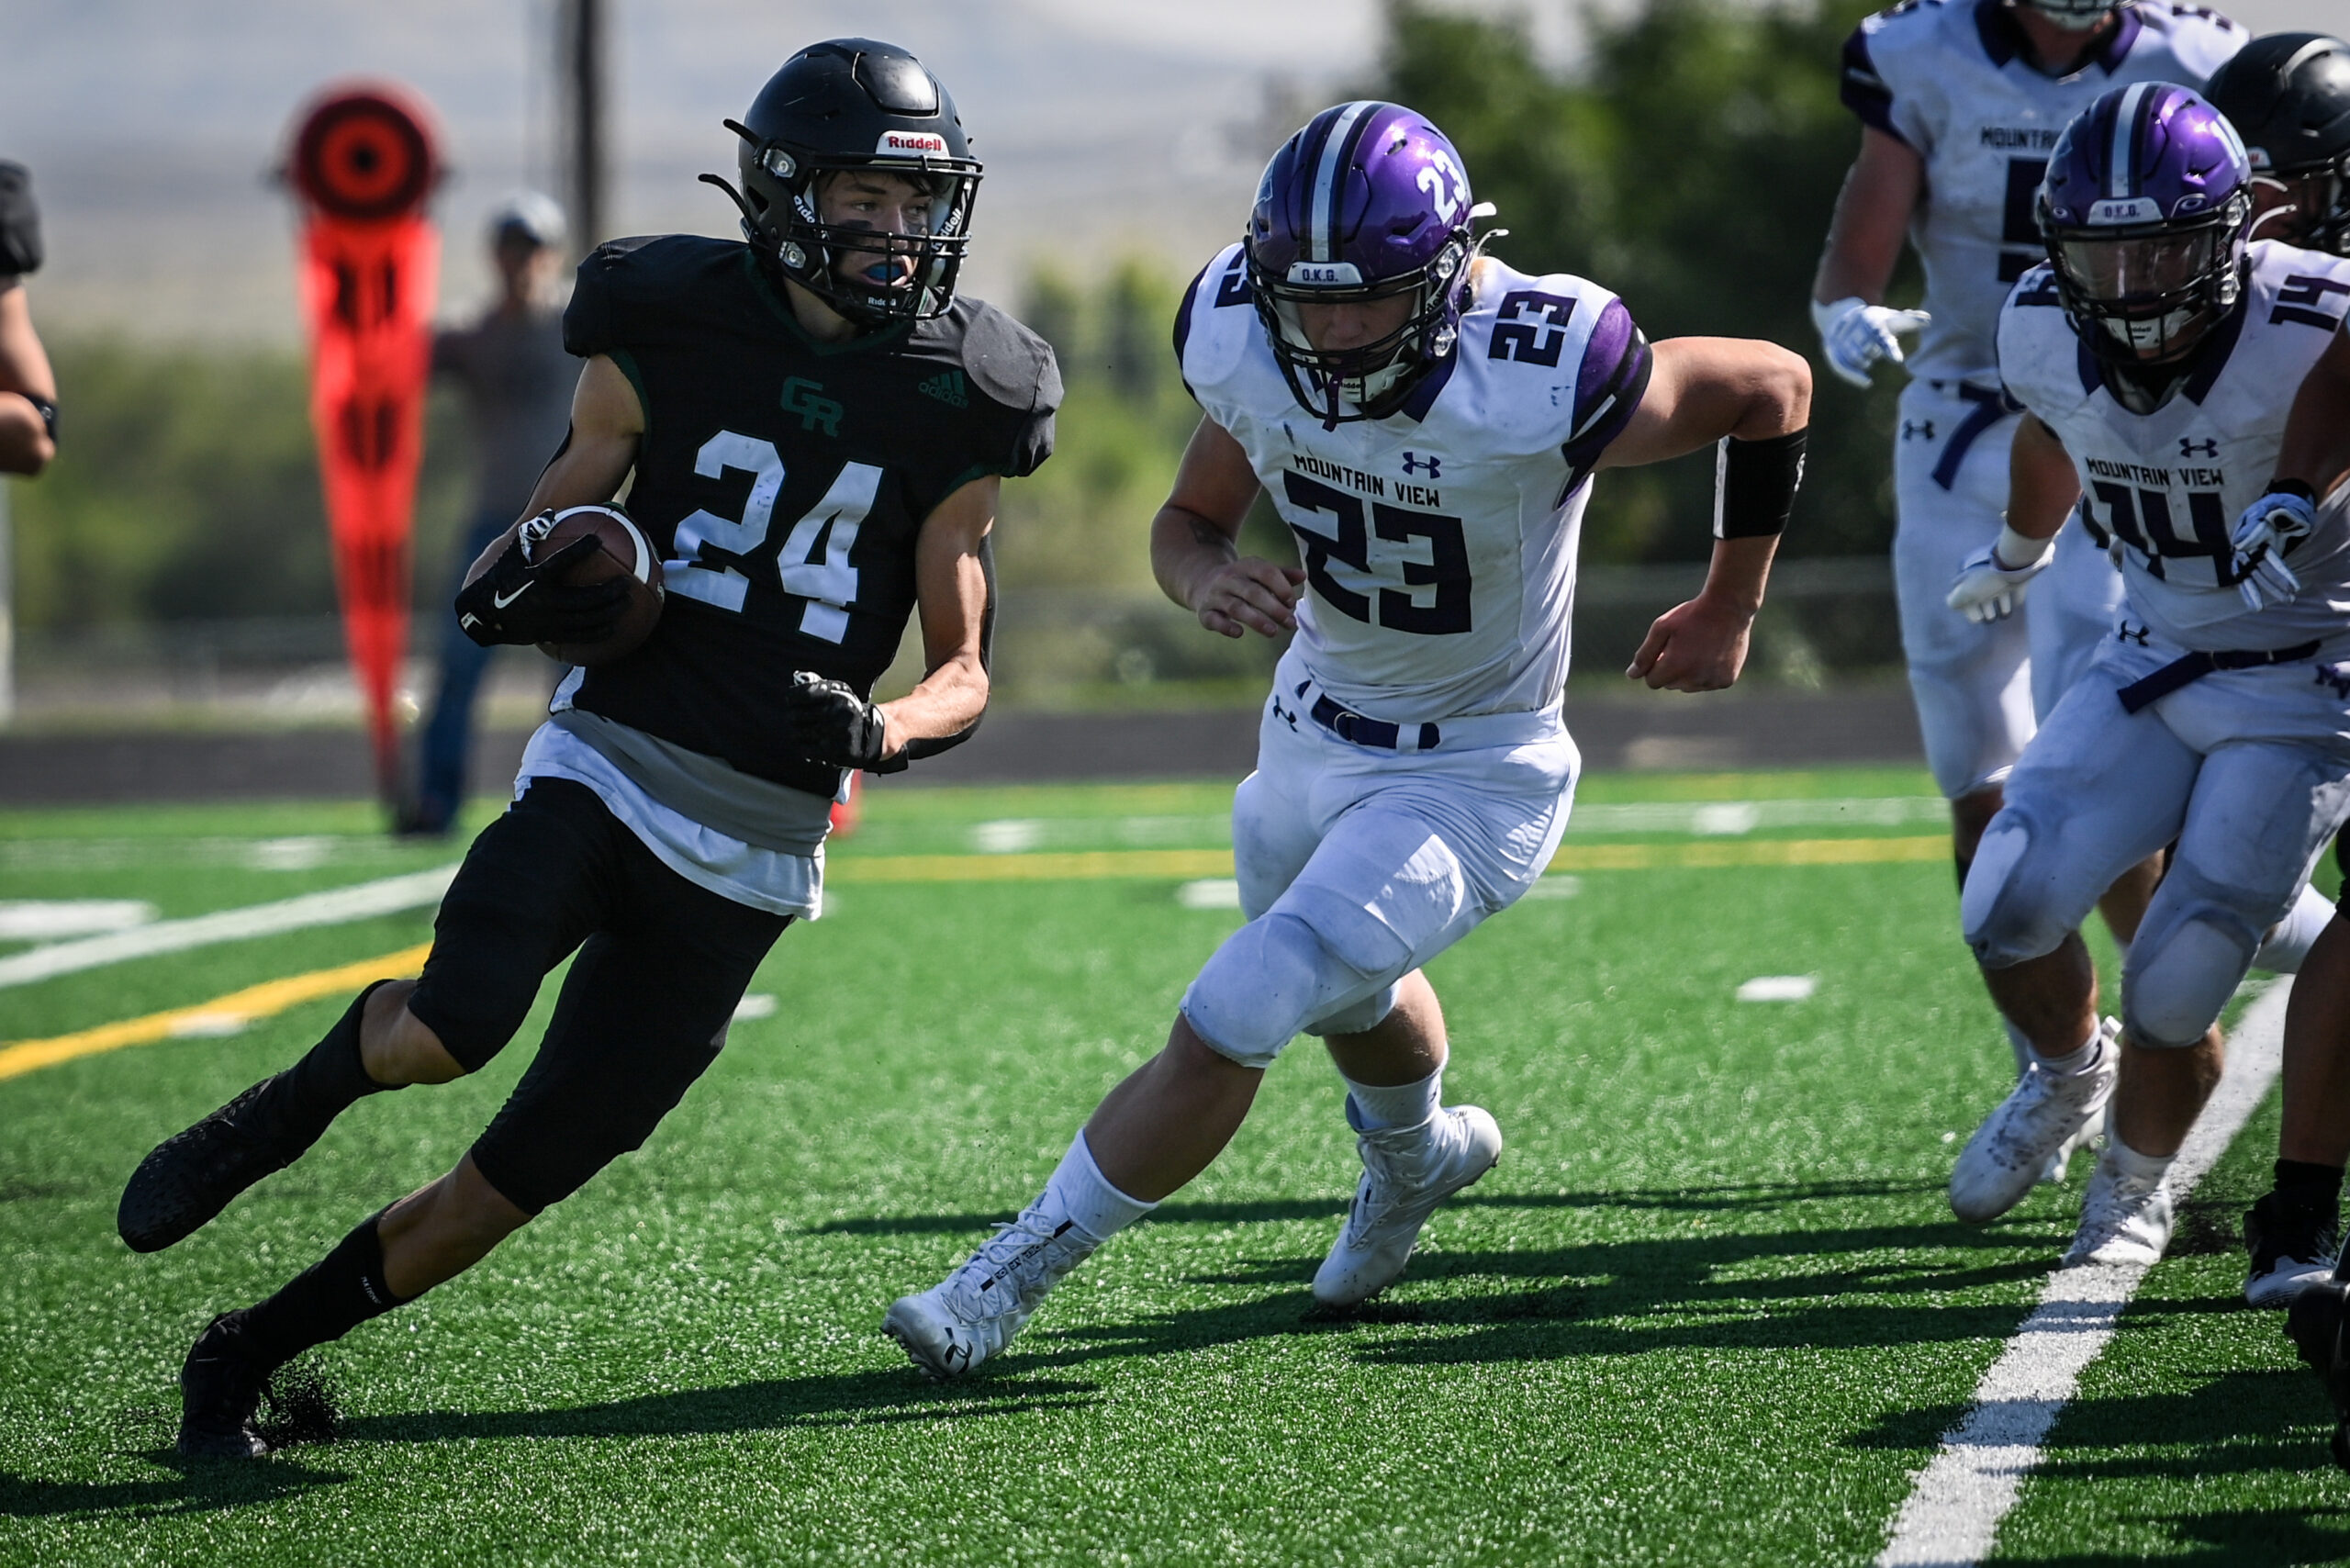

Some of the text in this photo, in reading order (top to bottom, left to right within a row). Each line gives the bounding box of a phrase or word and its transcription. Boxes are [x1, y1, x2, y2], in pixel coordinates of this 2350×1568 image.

[888, 135, 942, 151] Riddell
[1980, 126, 2059, 150] MOUNTA
[1416, 149, 1467, 225] 23
[1488, 289, 1578, 368] 23
[2267, 274, 2350, 333] 14
[780, 375, 845, 438] GR
[918, 381, 969, 409] adidas
[1292, 454, 1440, 507] MOUNTAIN VIEW
[2085, 456, 2224, 486] MOUNTAIN VIEW
[662, 429, 884, 645] 24
[1282, 467, 1472, 635] 23
[2091, 479, 2234, 588] 14
